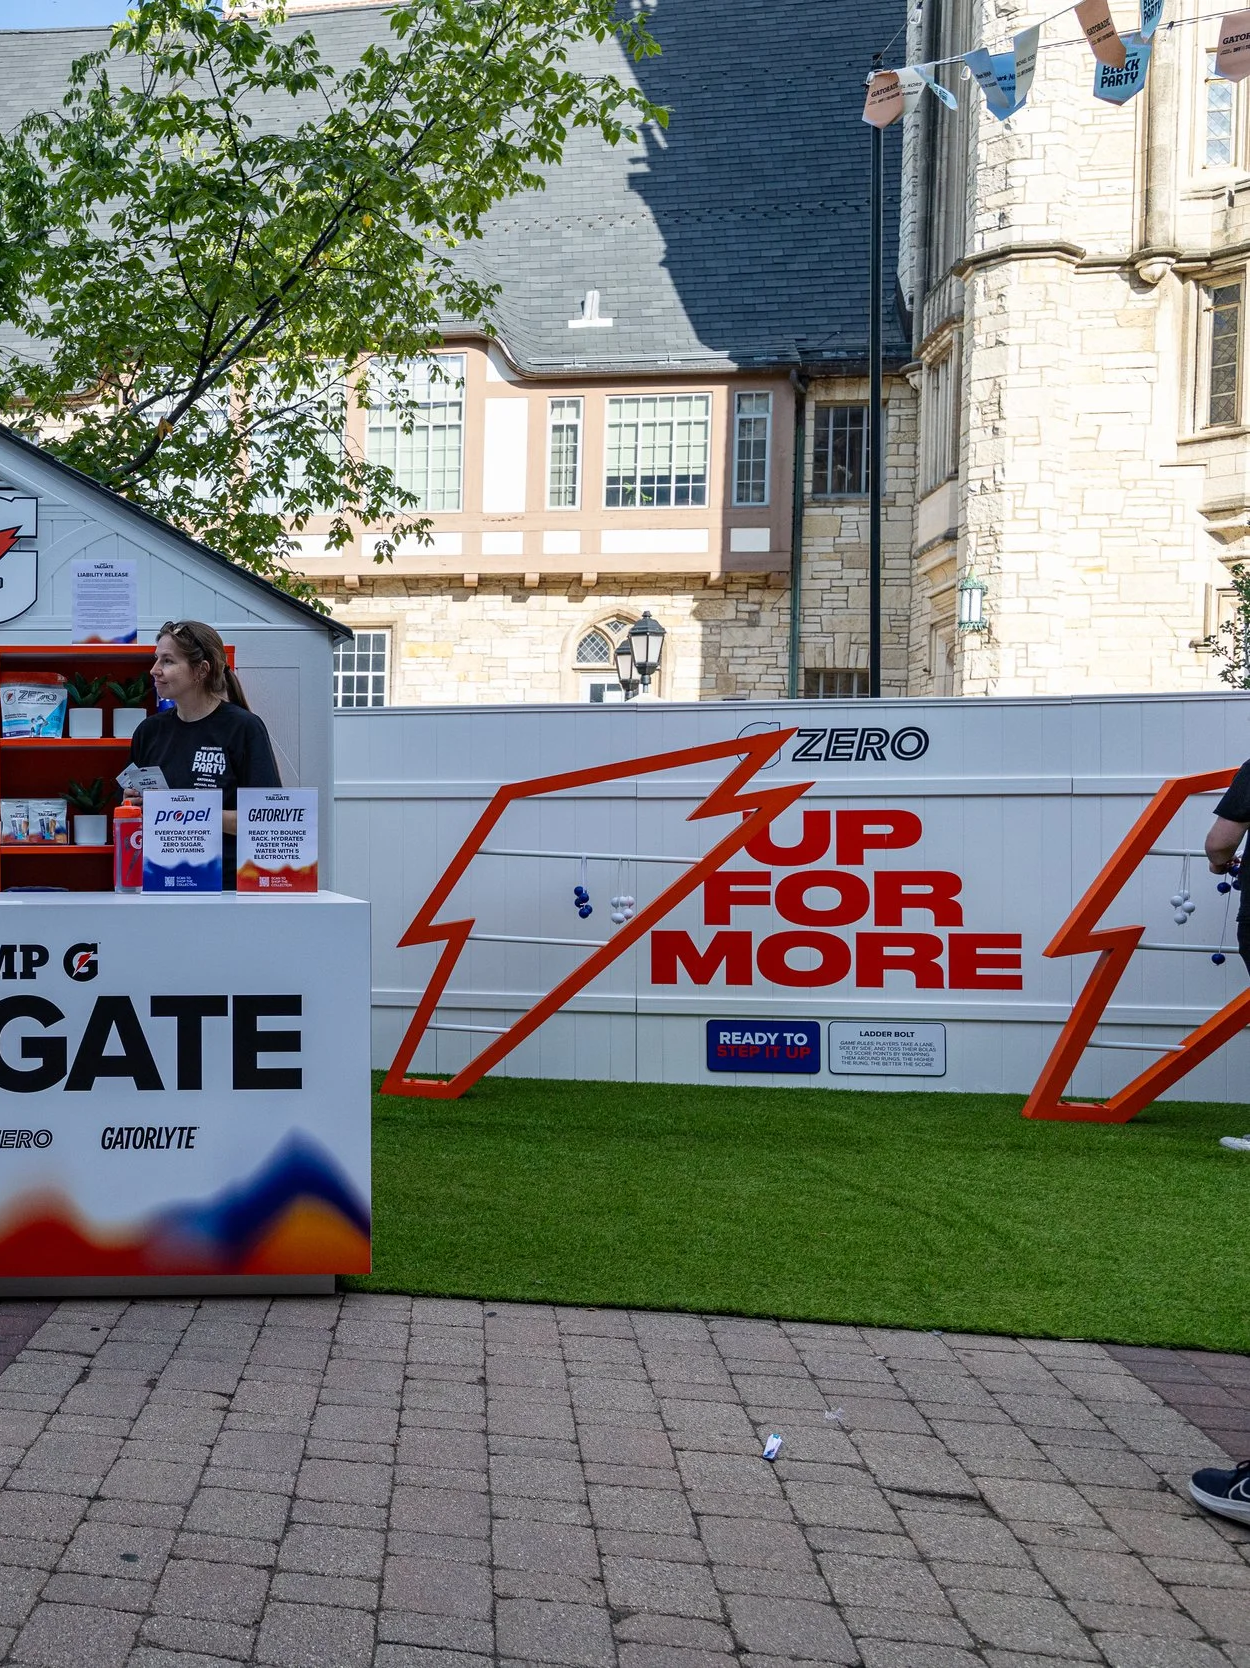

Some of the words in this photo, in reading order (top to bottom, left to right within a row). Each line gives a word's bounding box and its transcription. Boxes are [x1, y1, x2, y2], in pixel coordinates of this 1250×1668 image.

[1087, 18, 1111, 36] GATORADE
[1100, 71, 1138, 88] PARTY
[18, 690, 57, 702] ZERO
[792, 726, 930, 762] ZERO
[194, 751, 225, 764] BLOCK
[192, 762, 226, 775] PARTY
[154, 808, 211, 825] propel
[248, 808, 305, 822] GATORLYTE
[742, 809, 922, 866] UP
[704, 870, 963, 927] FOR
[63, 943, 98, 982] G
[650, 930, 1022, 990] MORE
[719, 1032, 779, 1045] READY
[783, 1033, 808, 1046] TO
[717, 1045, 760, 1057] STEP
[766, 1046, 781, 1058] IT
[786, 1046, 812, 1059] UP
[101, 1126, 198, 1150] GATORLYTE
